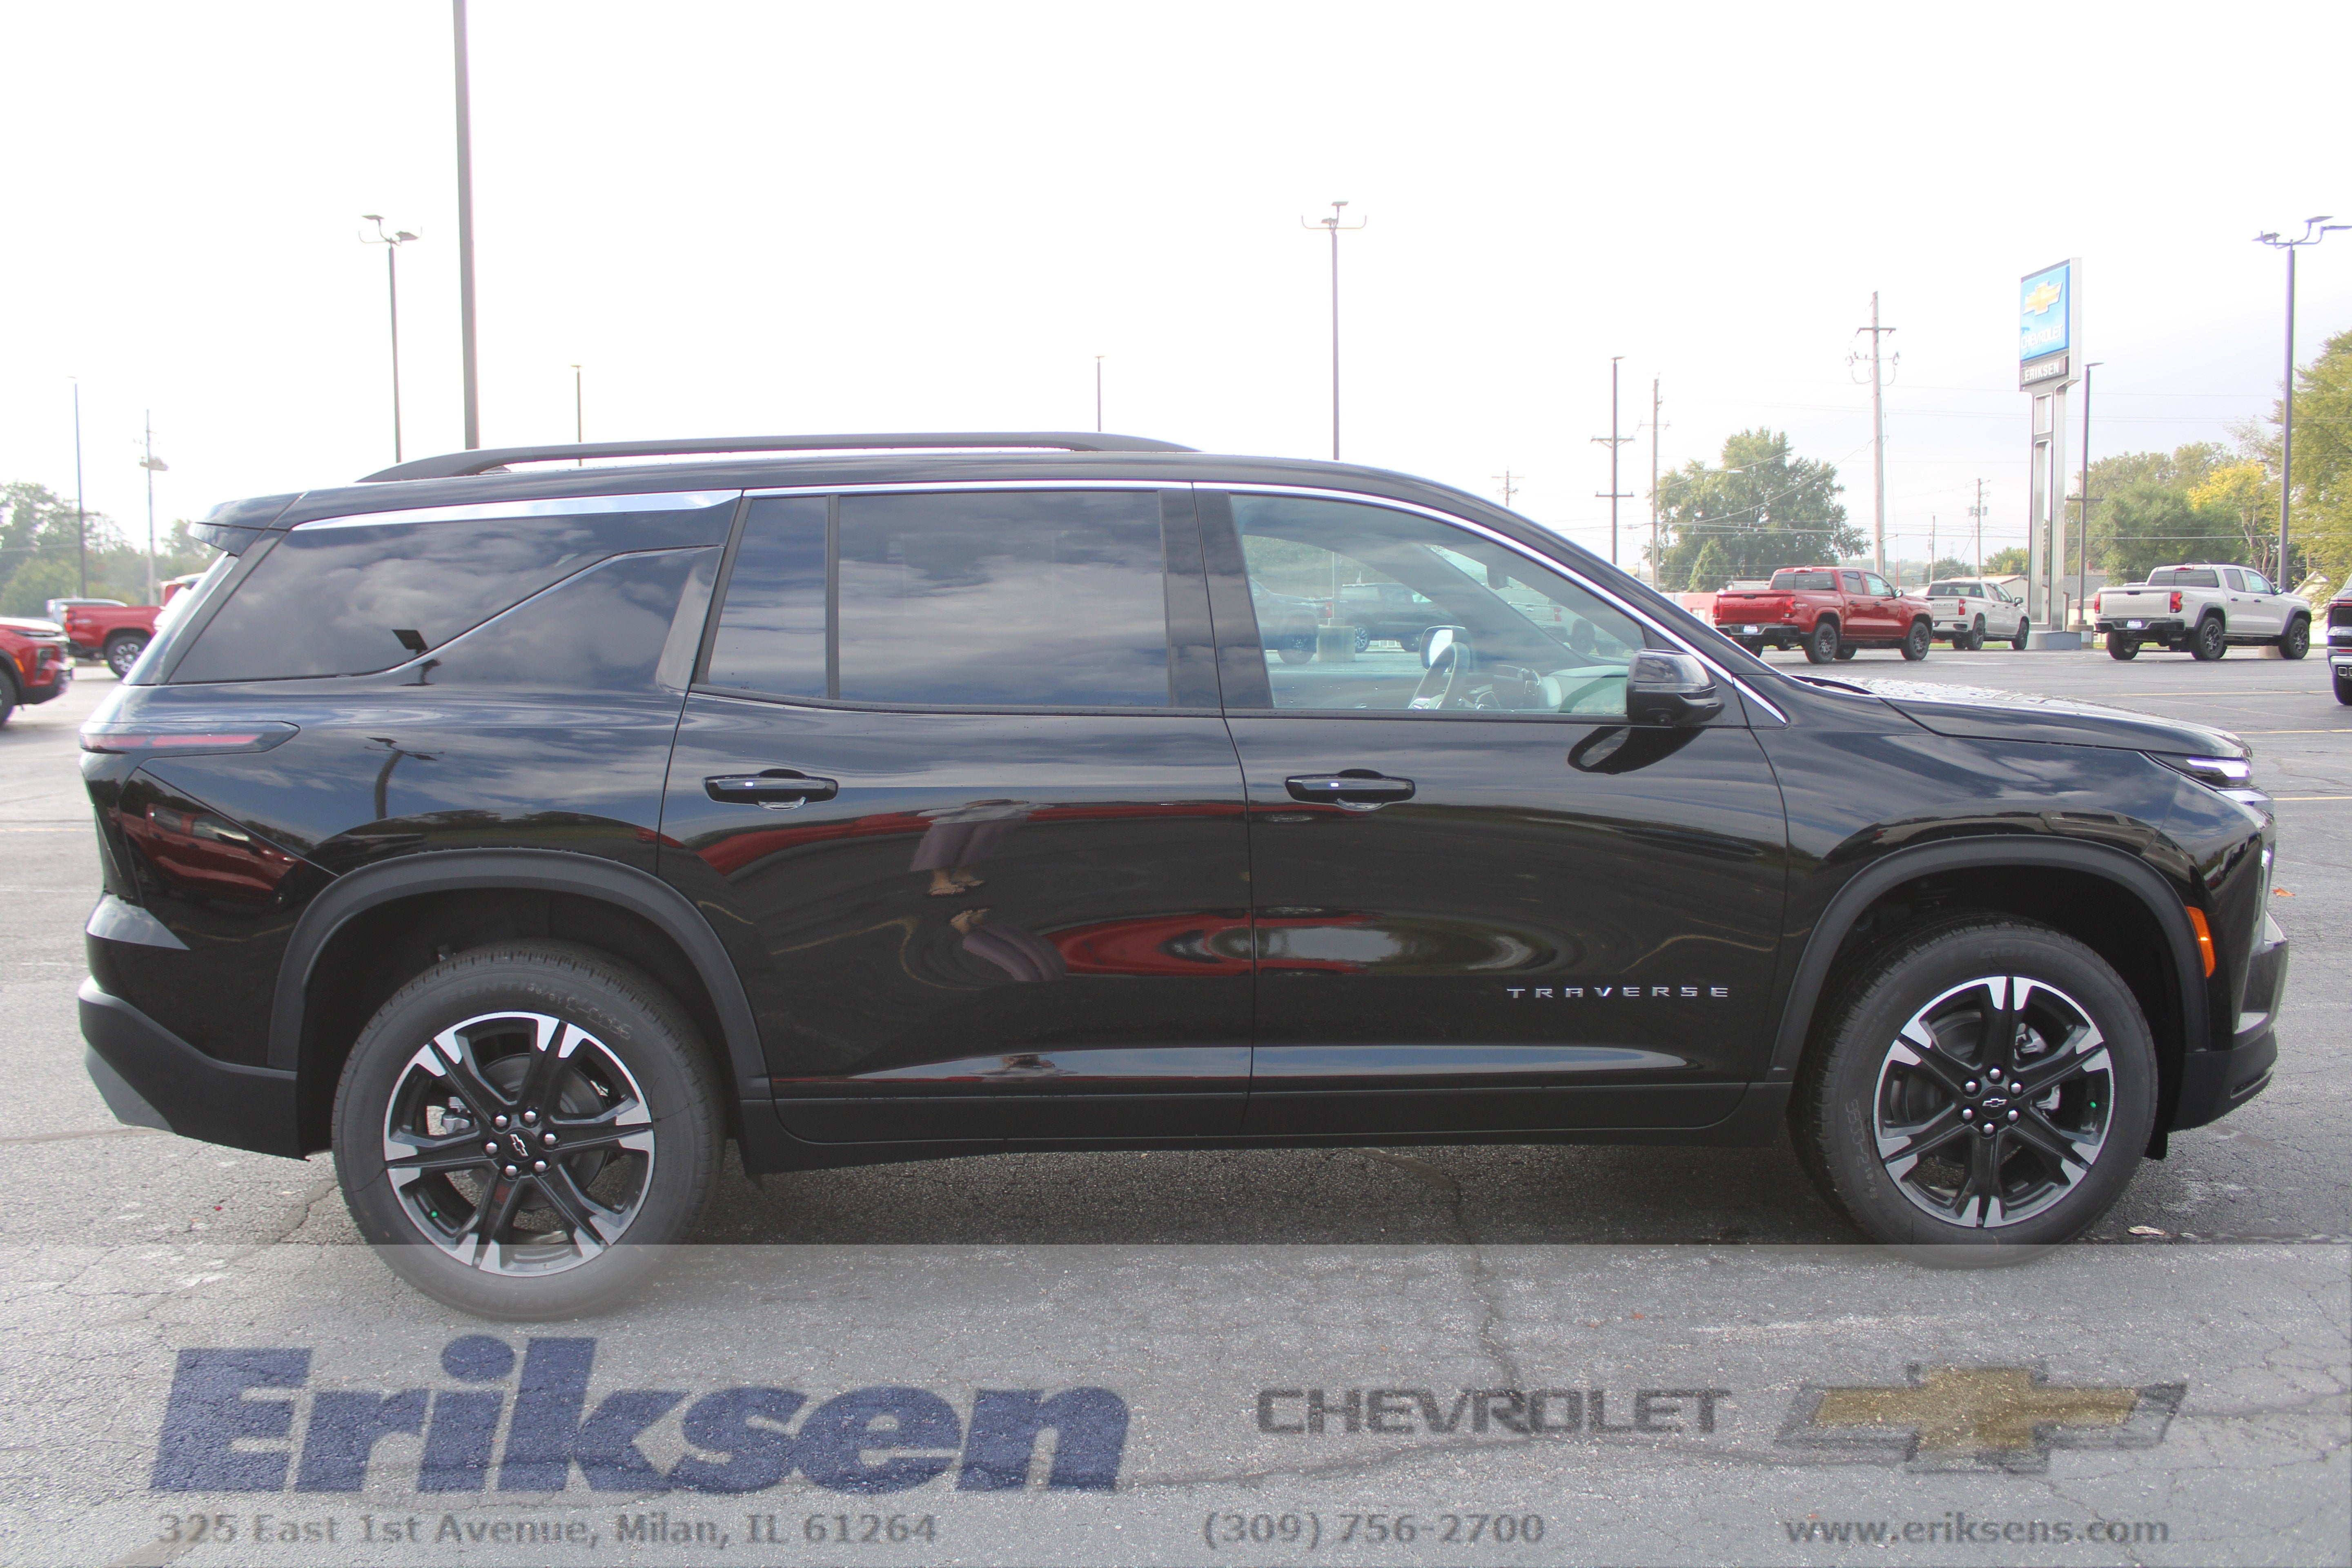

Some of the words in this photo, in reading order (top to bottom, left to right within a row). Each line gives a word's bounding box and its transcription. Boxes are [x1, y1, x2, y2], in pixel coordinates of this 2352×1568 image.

[2022, 325, 2063, 349] CHEVROLET
[2024, 361, 2060, 382] ERIKSEN
[1507, 987, 1729, 998] TRAVERSE
